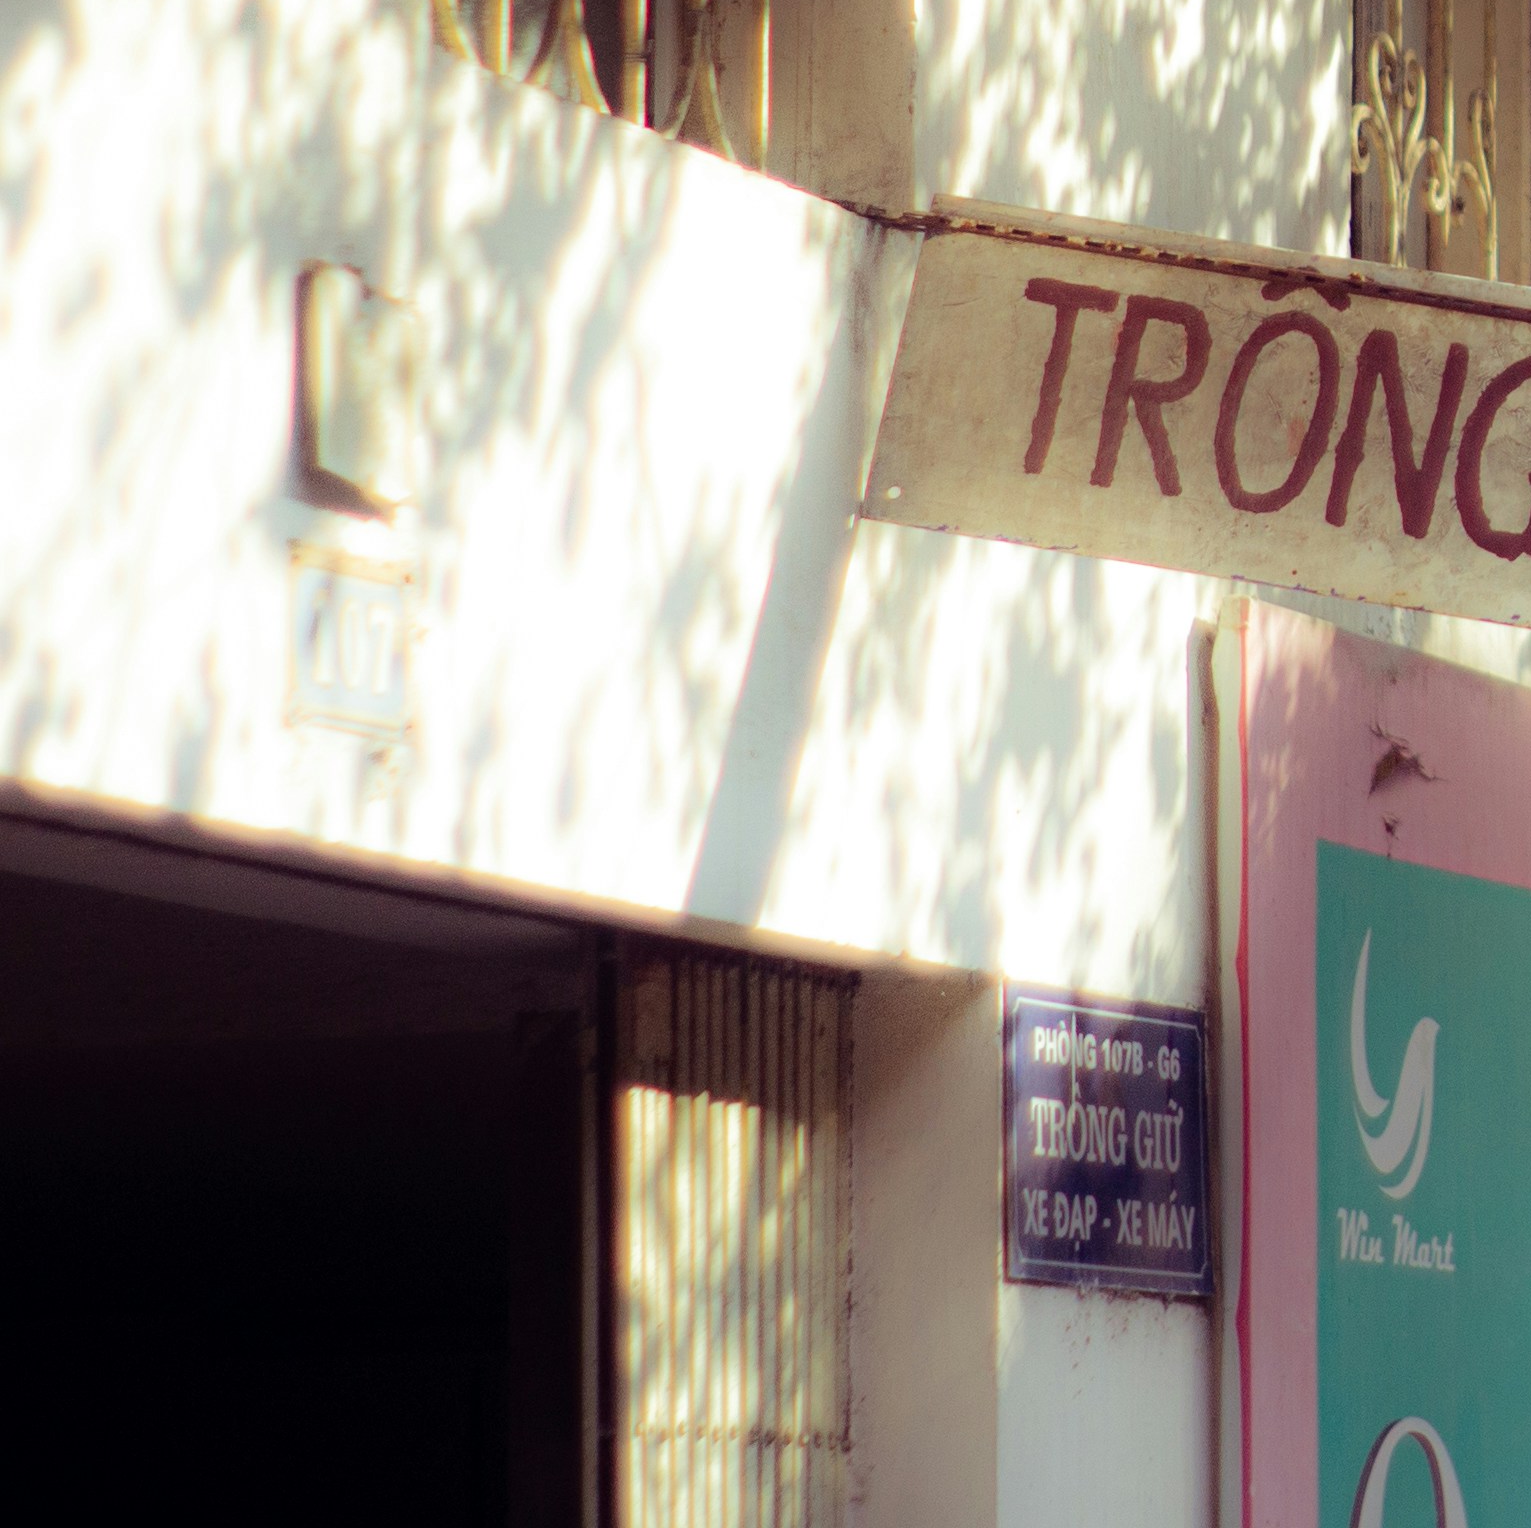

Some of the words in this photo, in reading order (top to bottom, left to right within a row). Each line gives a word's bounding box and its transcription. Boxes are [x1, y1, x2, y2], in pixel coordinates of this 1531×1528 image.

[312, 589, 395, 696] 107
[1033, 1020, 1097, 1071] PHÒNG
[1102, 1037, 1144, 1076] 107B
[1157, 1045, 1181, 1081] G6
[1030, 1080, 1128, 1167] TRÔNG
[1023, 1187, 1049, 1237] XE
[1053, 1191, 1098, 1251] ĐẠP
[1116, 1197, 1142, 1246] XE
[1147, 1189, 1196, 1250] MÁY
[1337, 1206, 1385, 1264] Win
[1391, 1212, 1455, 1272] Mart
